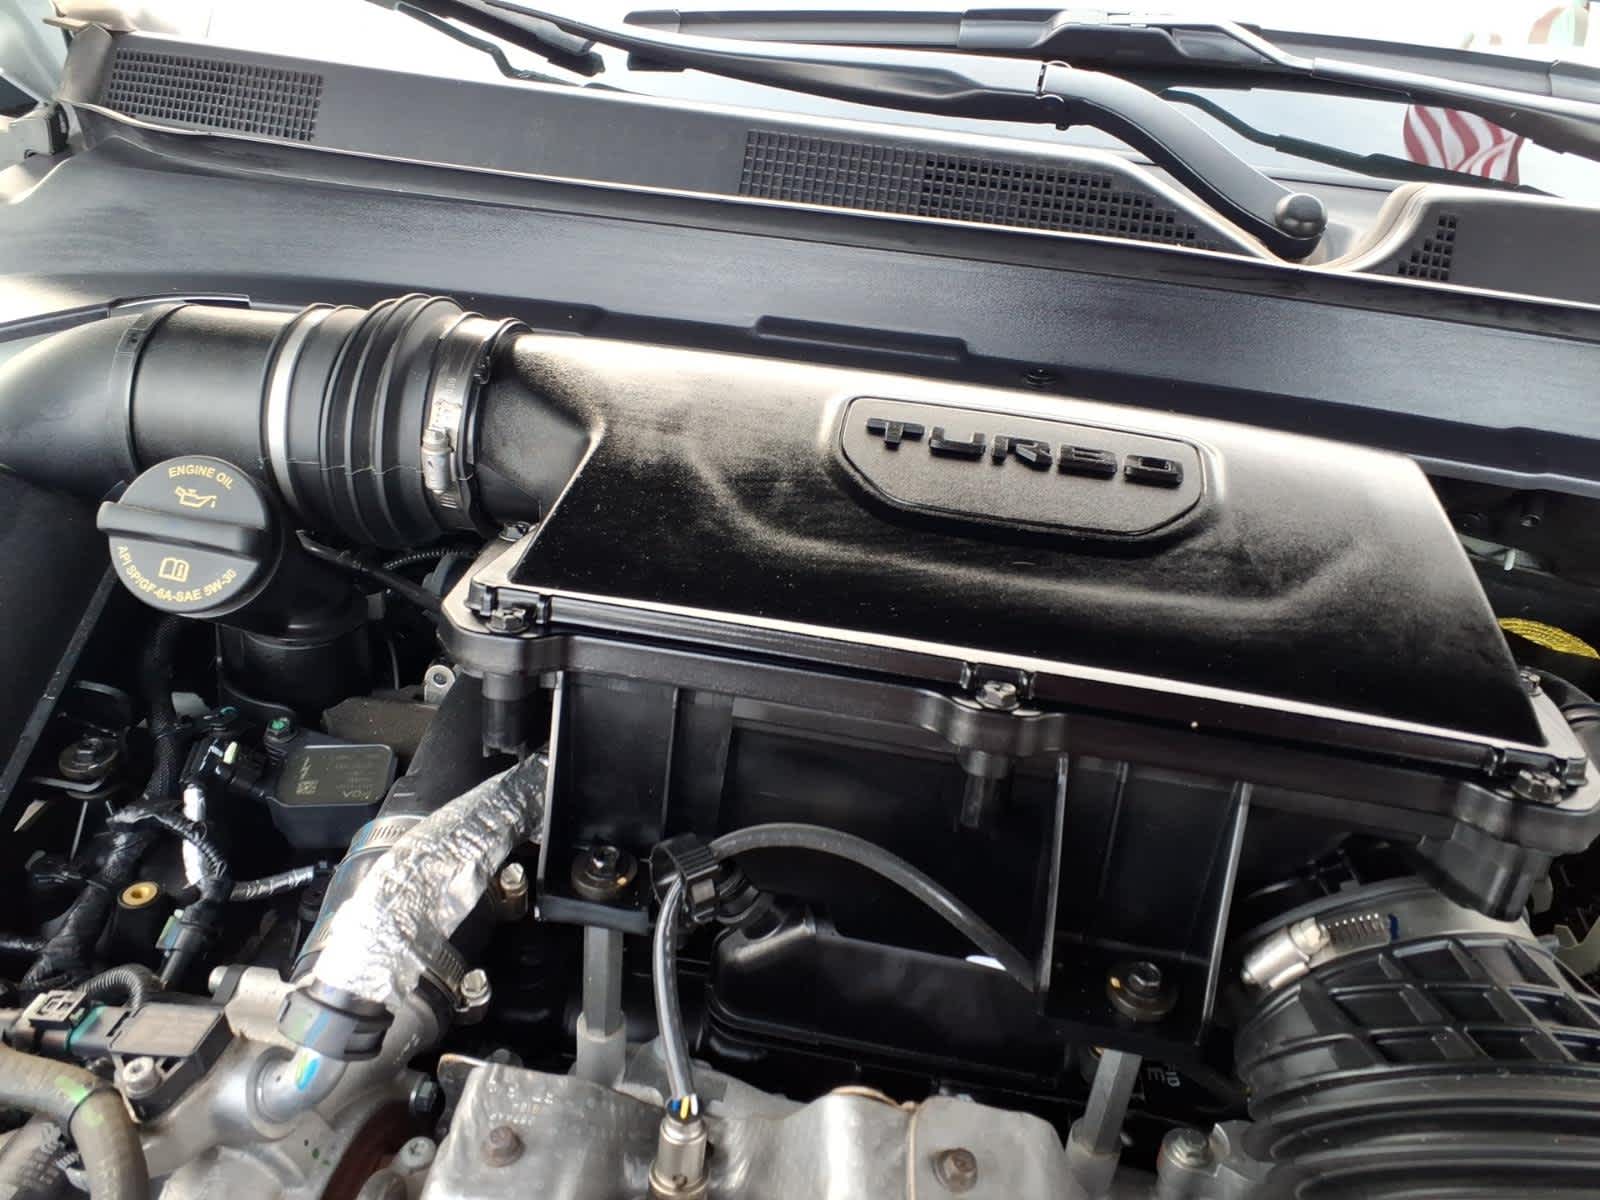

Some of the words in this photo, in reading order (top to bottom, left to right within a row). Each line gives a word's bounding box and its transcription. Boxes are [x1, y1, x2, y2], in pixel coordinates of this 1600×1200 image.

[168, 465, 215, 478] ENGINE
[216, 472, 234, 490] OIL
[865, 417, 1184, 488] TURBO
[117, 545, 131, 566] API
[204, 568, 237, 596] 5W-30
